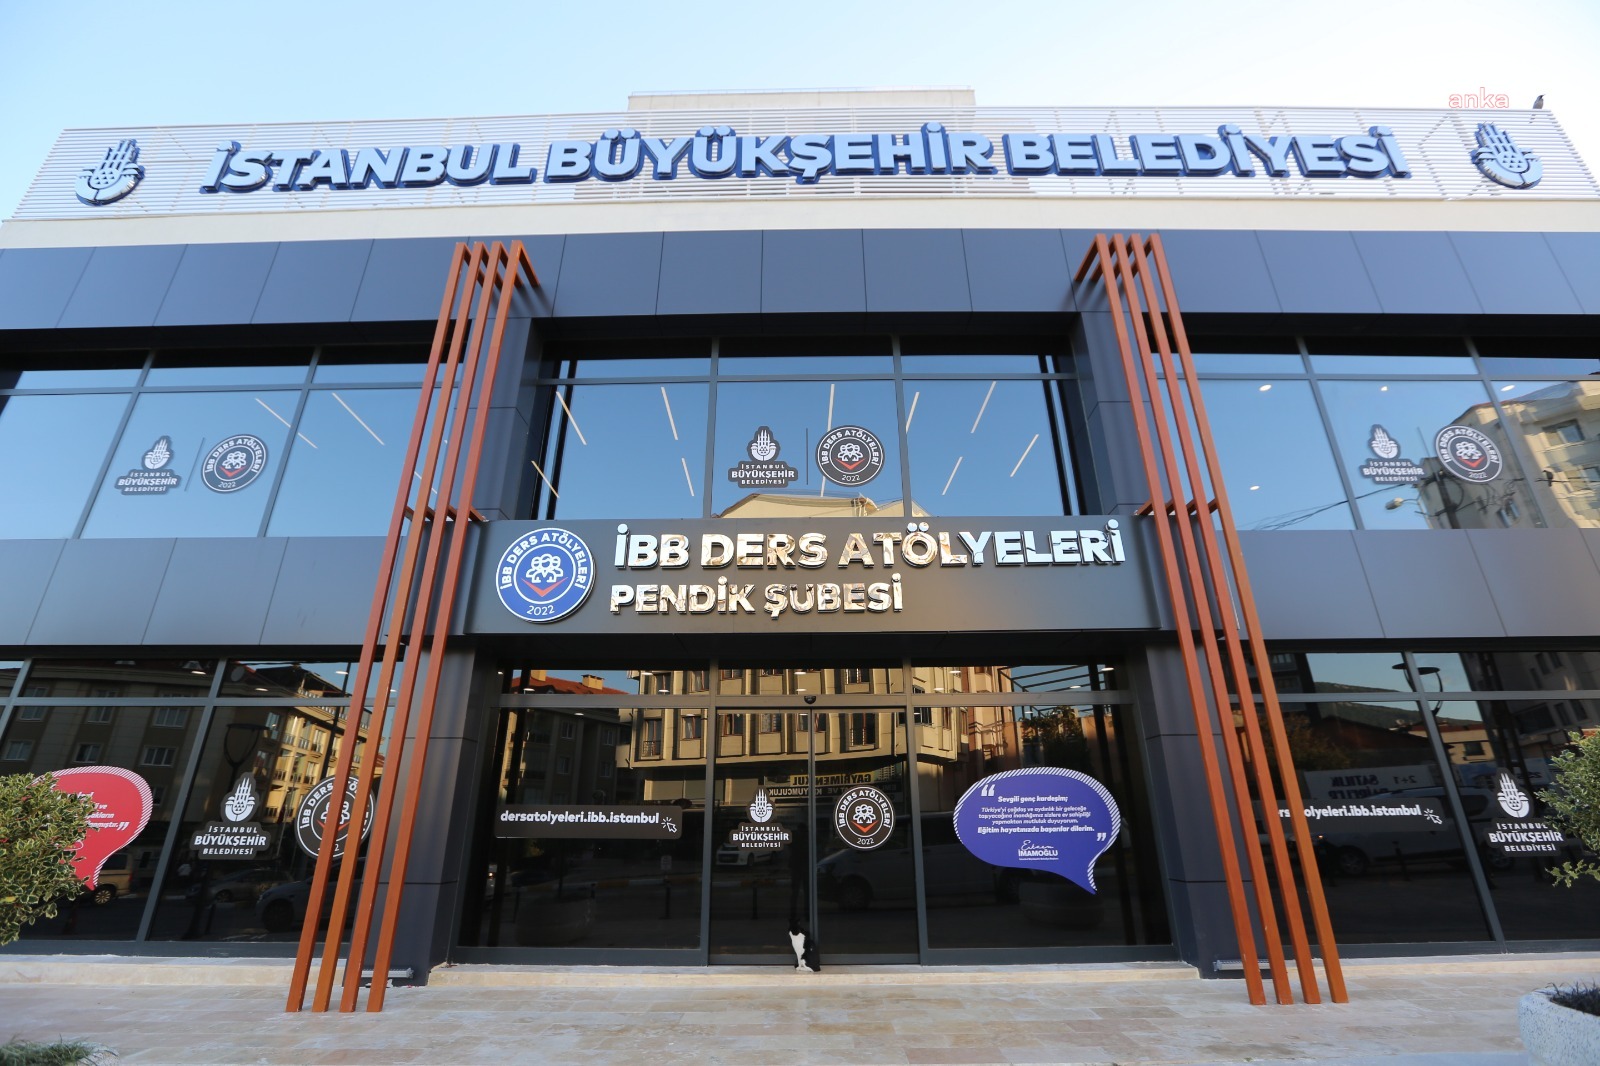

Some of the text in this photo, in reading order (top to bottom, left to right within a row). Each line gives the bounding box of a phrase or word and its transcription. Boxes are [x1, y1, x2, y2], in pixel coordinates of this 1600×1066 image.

[201, 121, 1411, 193] İSTANBUL BÜYÜKŞEHİR BELEDİYESİ
[821, 429, 879, 466] İBB DERS ATÖLYELERİ
[212, 440, 235, 458] DERS
[236, 438, 262, 473] ATÖLYELERİ
[731, 469, 795, 479] BÜYÜKŞEHİR
[118, 477, 178, 486] BÜYÜKŞEHİR
[614, 518, 1126, 569] İBB DERS ATÖLYELERİ
[500, 532, 588, 590] İBB DERS ATÖLYELERİ
[609, 572, 903, 620] PENDİK ŞUBESİ
[526, 605, 555, 616] 2022
[300, 783, 334, 829] İBB DERS
[840, 792, 858, 811] DERS
[859, 790, 891, 828] ATÖLYELERİ
[1278, 804, 1422, 820] rsolyeleri.ibb.istanbul
[500, 810, 660, 824] dersatolyeleri.ibb.istanbul
[732, 832, 789, 841] BÜYÜKŞEHİR
[1000, 826, 1040, 834] hayatınızda
[1488, 830, 1564, 843] BÜYÜKŞEHİR
[194, 833, 266, 846] BÜYÜKŞEHİR
[203, 847, 254, 855] BELEDİYESİ
[1504, 843, 1556, 852] BELEDİYESİ
